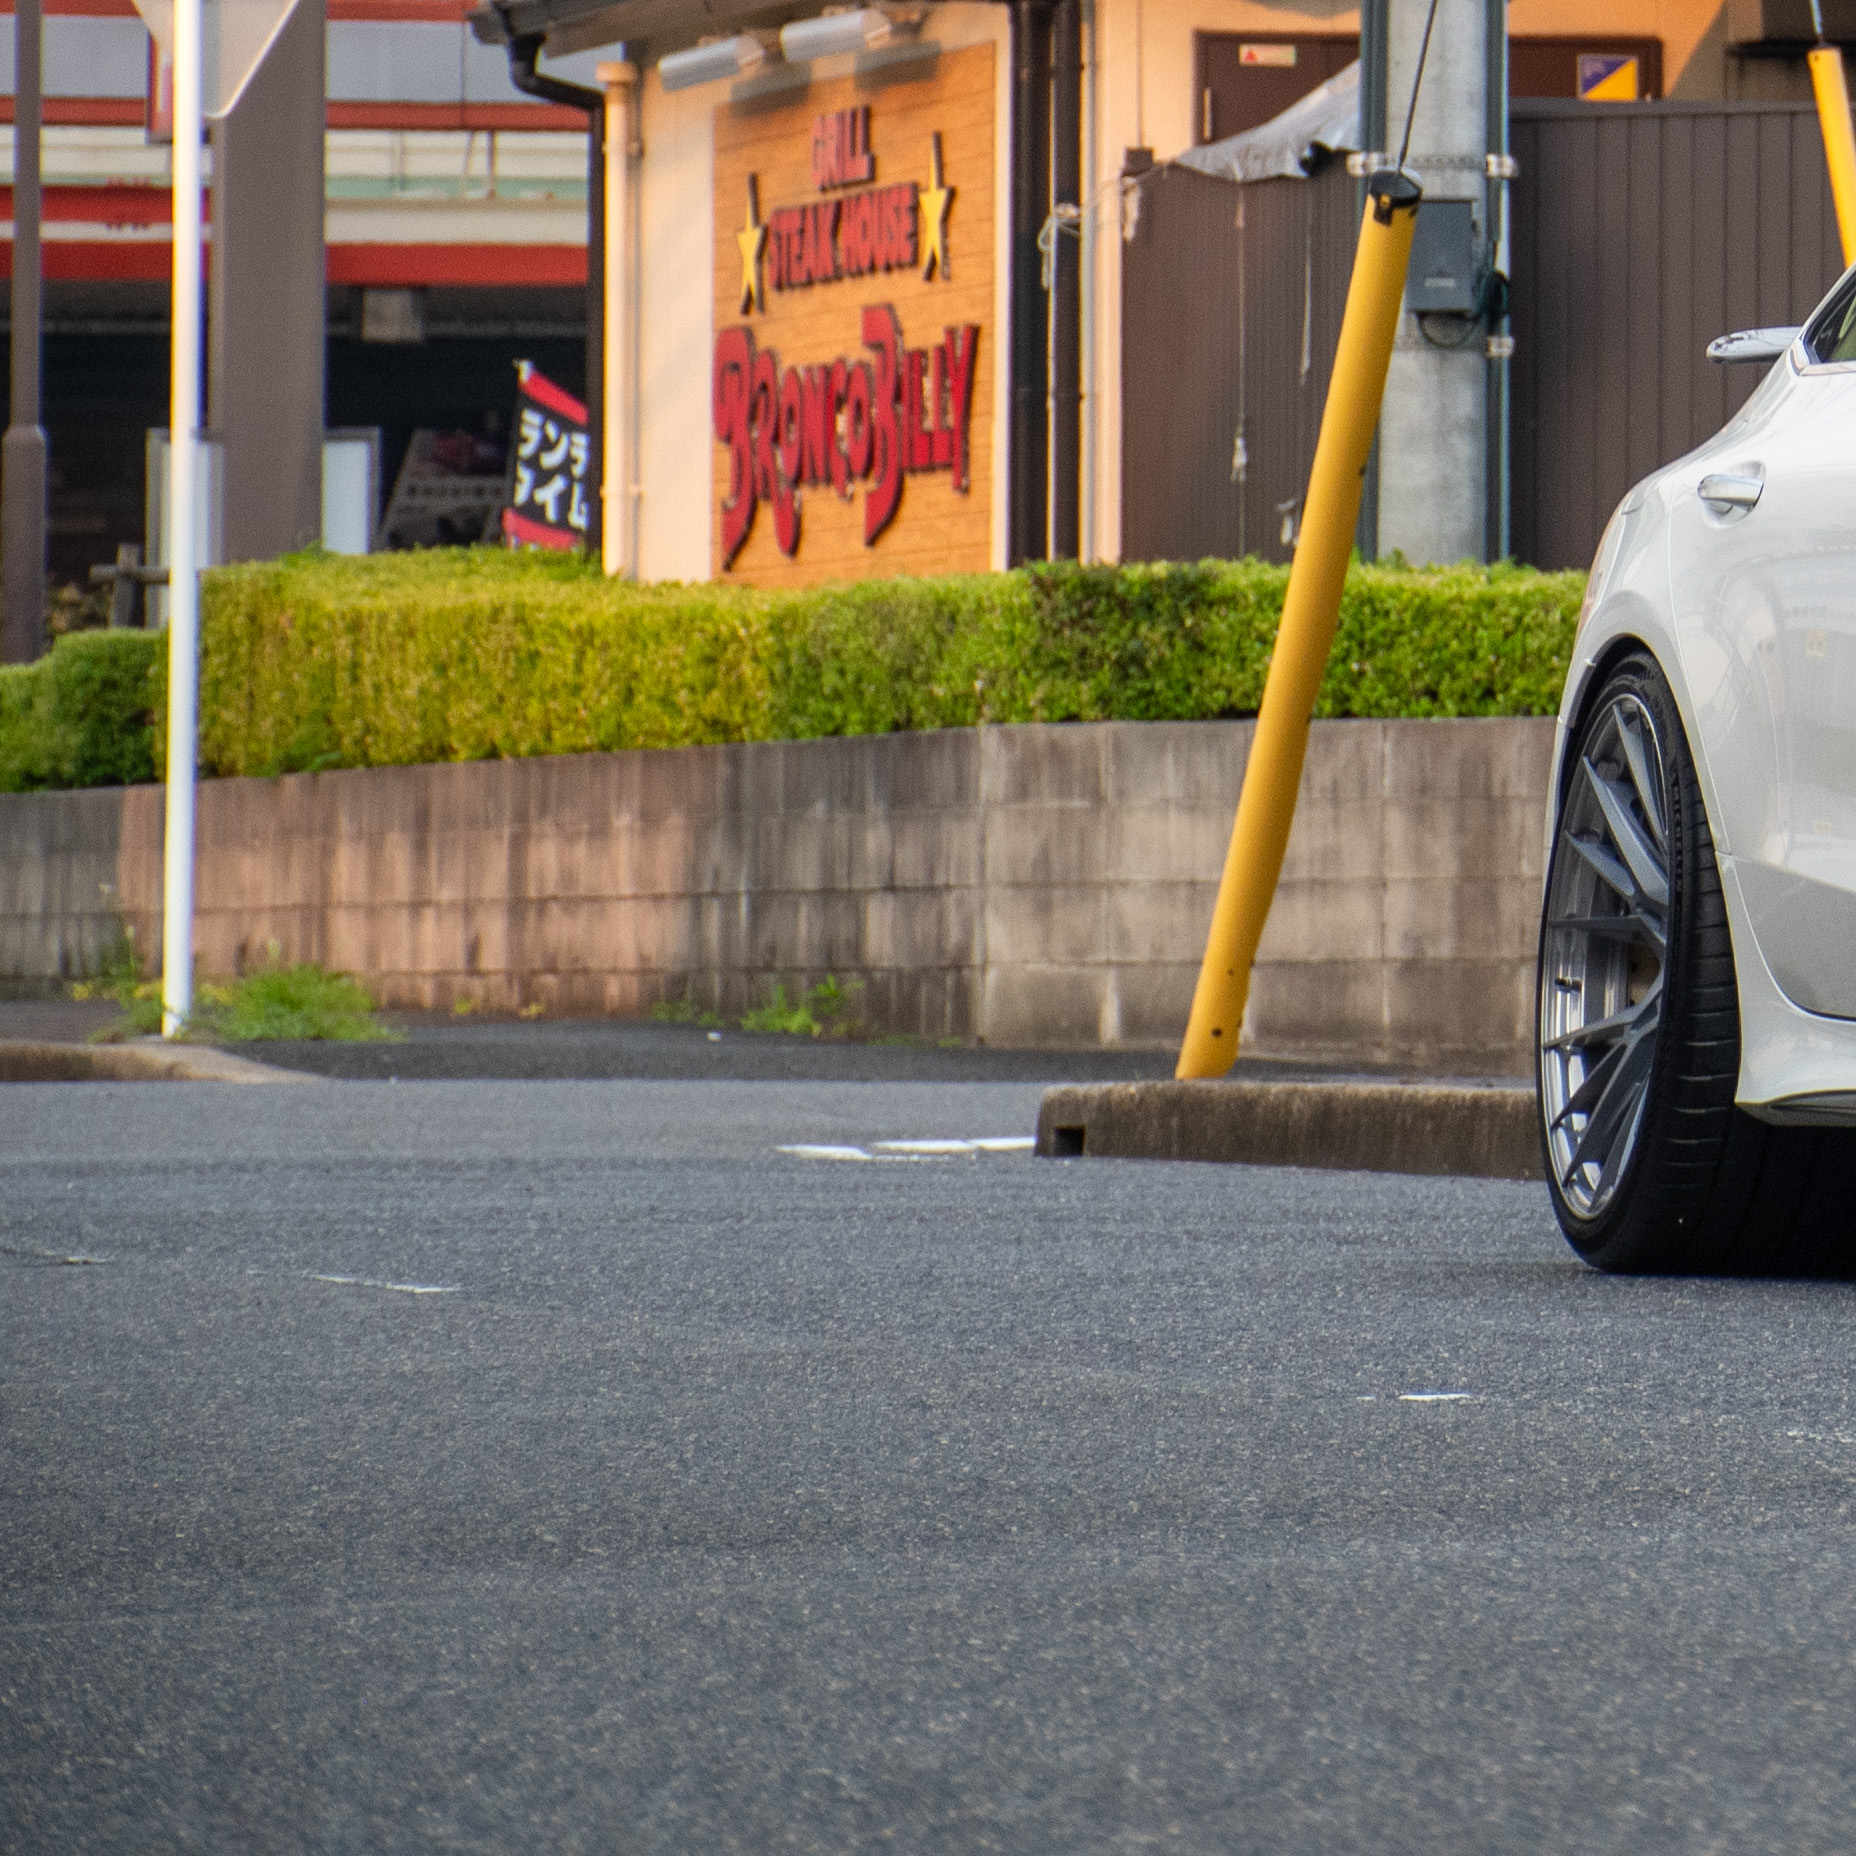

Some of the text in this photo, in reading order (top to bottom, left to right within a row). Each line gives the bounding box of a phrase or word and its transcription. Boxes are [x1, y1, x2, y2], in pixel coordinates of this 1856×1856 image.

[811, 104, 875, 192] GRILL
[768, 181, 919, 292] STEAK HOUSE
